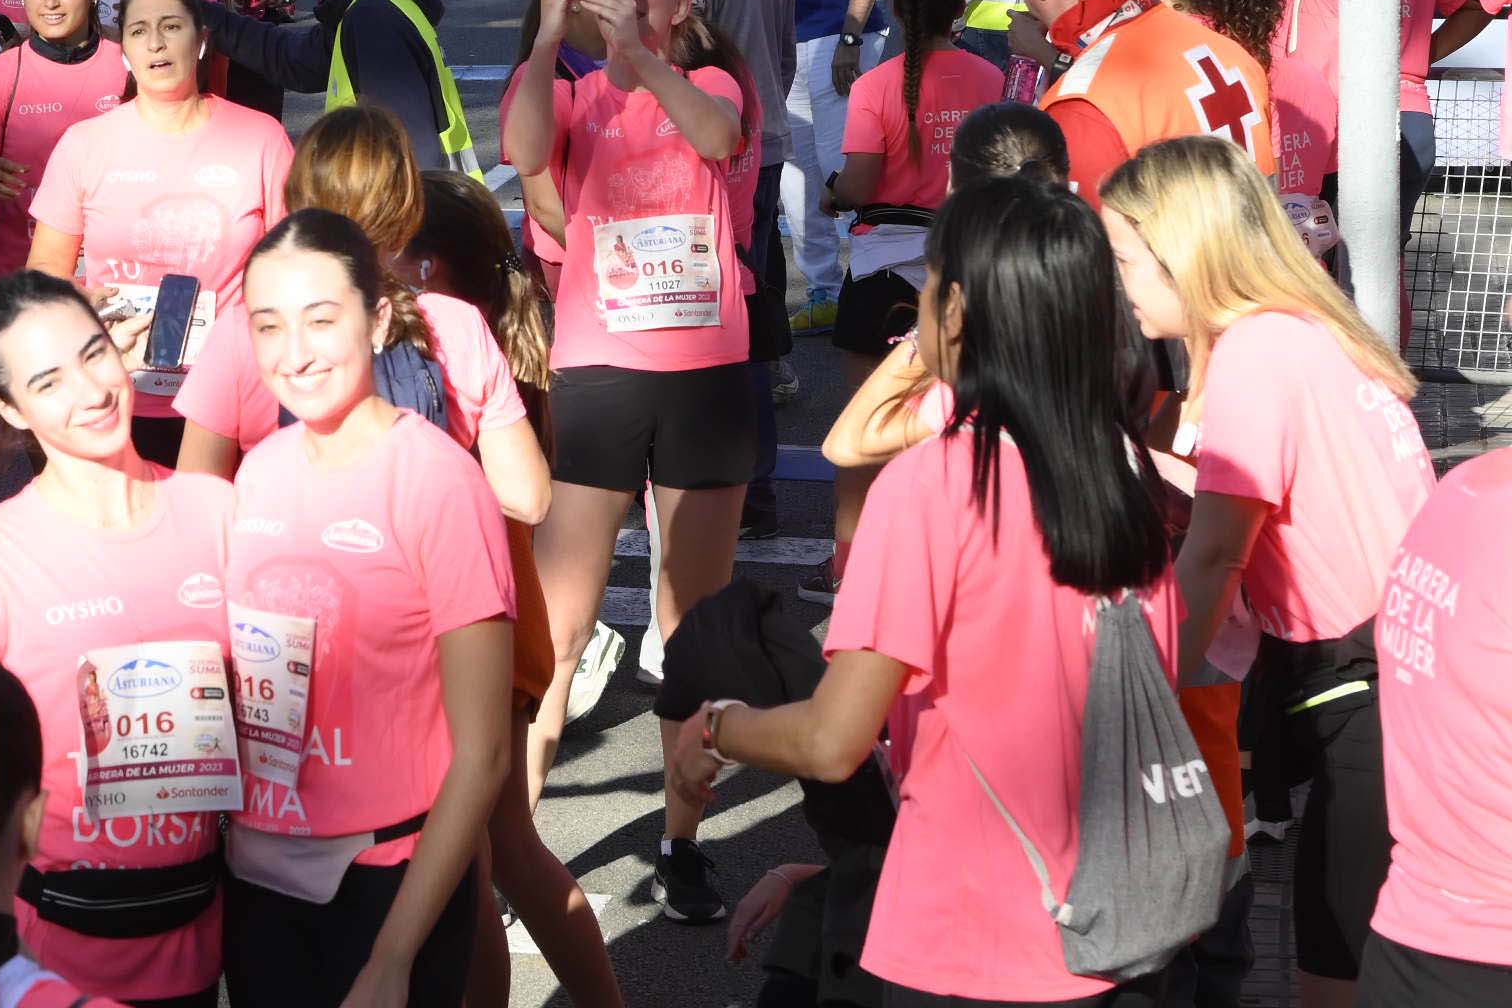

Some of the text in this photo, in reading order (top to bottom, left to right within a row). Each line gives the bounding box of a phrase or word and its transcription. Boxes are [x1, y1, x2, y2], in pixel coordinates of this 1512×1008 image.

[19, 102, 63, 115] OYSHO
[106, 259, 141, 280] TU
[642, 259, 684, 277] 016
[649, 280, 681, 291] 11027
[46, 595, 124, 625] OYSHO
[1386, 586, 1436, 637] DE LA
[1380, 623, 1436, 679] MUJER
[113, 675, 177, 691] ASTURIANA
[117, 711, 175, 737] 016
[122, 742, 169, 760] 16742
[126, 767, 139, 777] DE
[143, 765, 156, 776] LA
[158, 764, 196, 774] MUJER
[199, 762, 224, 772] 2023
[170, 786, 229, 799] Santander
